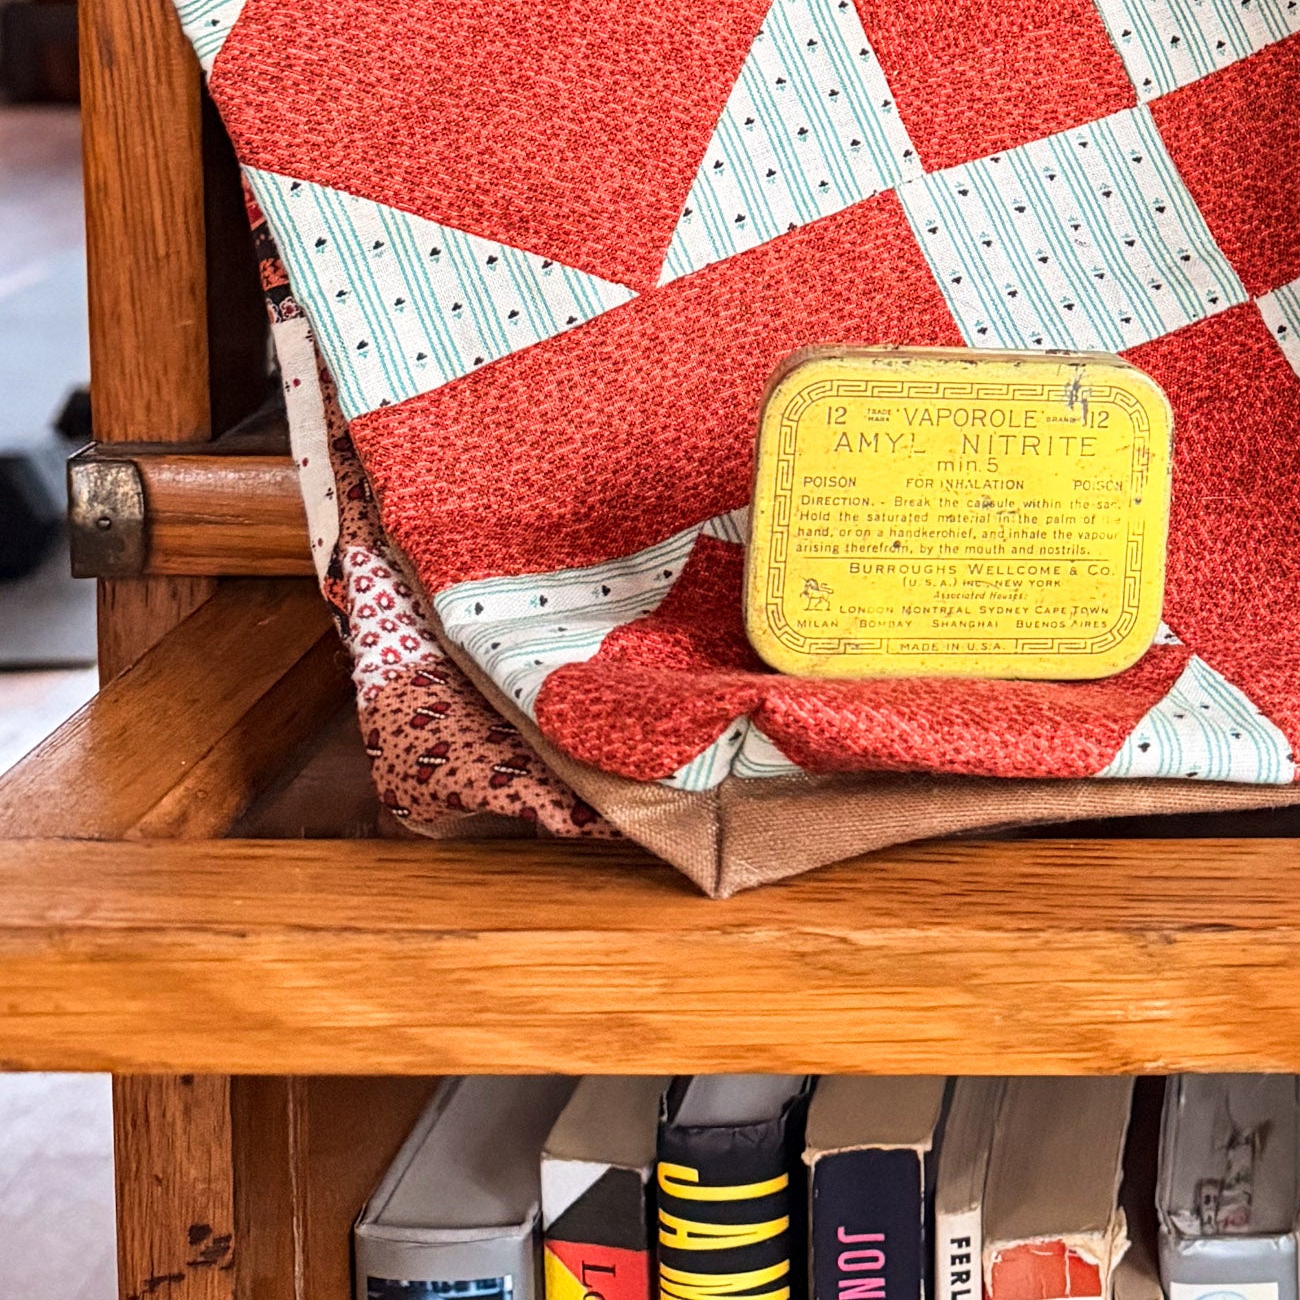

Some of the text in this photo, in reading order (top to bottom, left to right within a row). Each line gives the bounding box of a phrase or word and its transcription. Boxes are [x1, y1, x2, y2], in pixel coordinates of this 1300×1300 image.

[826, 406, 847, 425] 12
[1090, 410, 1109, 429] 12
[834, 431, 1097, 457] AMYL NITRITE
[803, 476, 857, 488] POISON
[906, 478, 1024, 490] FOR INHALATION
[894, 496, 930, 507] Break
[939, 496, 959, 507] the
[967, 498, 1015, 510] capsule
[1023, 499, 1061, 509] within
[1070, 499, 1089, 509] the
[800, 510, 830, 522] Hold
[839, 511, 859, 522] the
[867, 512, 928, 523] saturated
[937, 513, 990, 524] material
[998, 514, 1010, 524] in
[1018, 514, 1038, 524] the
[1046, 514, 1076, 526] palm
[1083, 515, 1096, 525] of
[797, 526, 833, 538] hand,
[839, 528, 851, 537] or
[856, 529, 871, 537] on
[982, 528, 1005, 540] and
[1009, 529, 1047, 540] inhale
[1053, 530, 1073, 540] the
[1079, 532, 1119, 541] vapour
[796, 542, 1091, 556] arising therefrom, by the mouth and nostrils.
[1069, 564, 1078, 576] &
[995, 579, 1023, 588] NEW
[1029, 579, 1061, 588] YORK
[933, 590, 985, 600] Associated
[900, 643, 939, 651] MADE
[946, 643, 959, 651] IN
